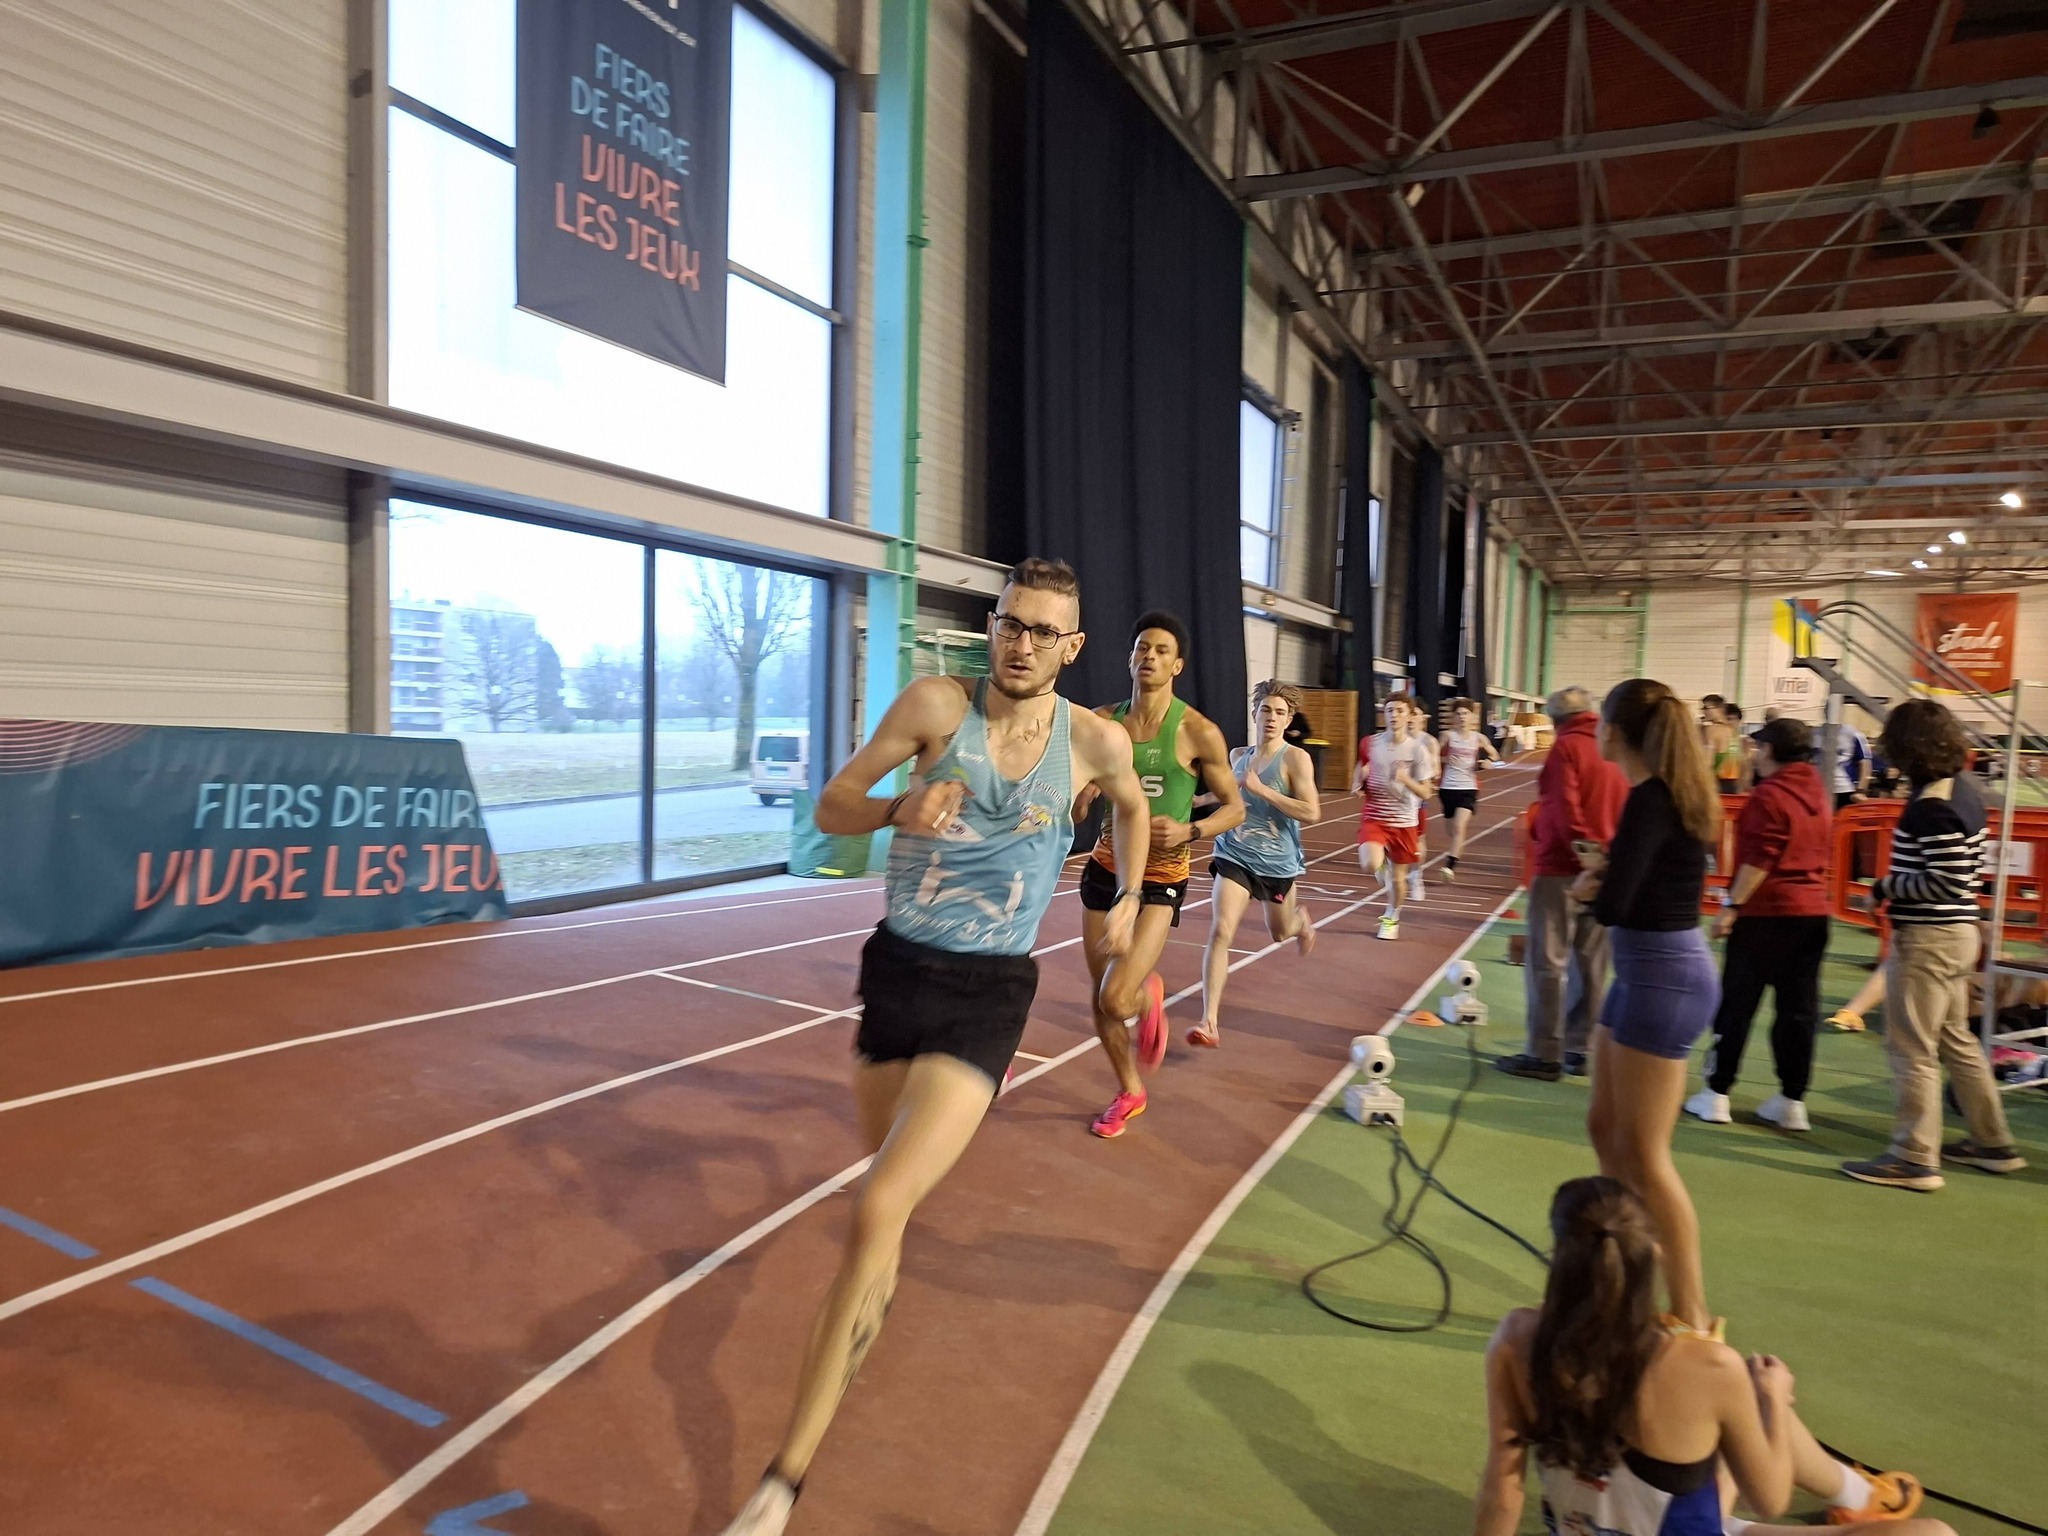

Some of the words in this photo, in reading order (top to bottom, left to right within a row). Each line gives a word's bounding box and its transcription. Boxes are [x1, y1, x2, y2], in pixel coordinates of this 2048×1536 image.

[595, 43, 671, 119] FIERS
[571, 75, 609, 130] DE
[615, 103, 690, 176] FAIRE
[582, 134, 681, 228] VIVRE
[555, 182, 619, 251] LES
[625, 217, 699, 292] JEUX
[195, 782, 321, 830] FIERS
[331, 786, 387, 829] DE
[134, 845, 311, 911] VIVRE
[323, 844, 408, 897] LES
[418, 844, 504, 893] JEU
